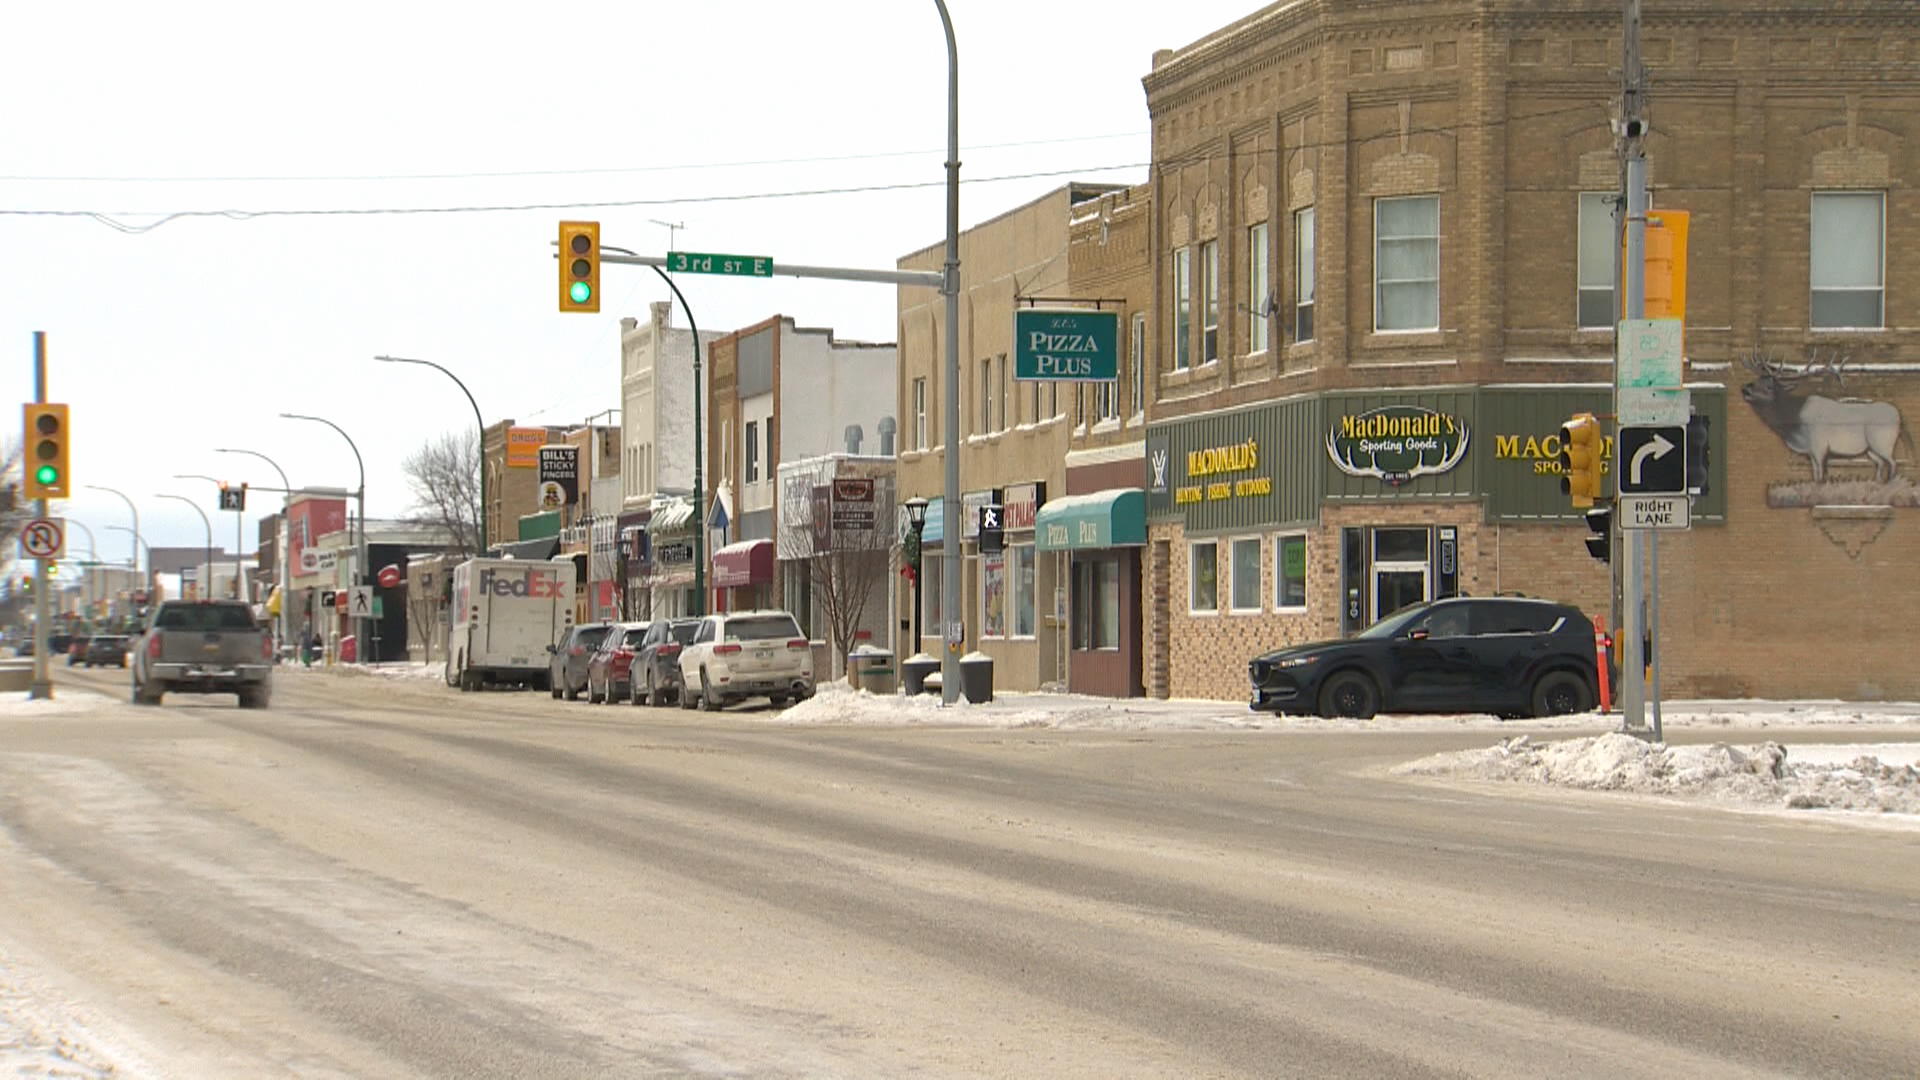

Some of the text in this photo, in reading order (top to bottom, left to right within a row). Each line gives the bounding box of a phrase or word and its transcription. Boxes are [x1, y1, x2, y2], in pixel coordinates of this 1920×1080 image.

[676, 255, 766, 274] 3rd ST E
[1029, 331, 1098, 352] PIZZA
[1035, 355, 1092, 375] PLUS
[1341, 412, 1455, 438] MacDonald's
[1360, 436, 1438, 454] Sporting Goods
[542, 450, 575, 460] BILL'S
[1187, 437, 1258, 476] MACDONALD'S
[542, 470, 576, 479] FINGERS
[543, 461, 575, 470] STICKY
[1176, 477, 1272, 503] HUNTING FISHING OUTDOORS
[1635, 500, 1673, 512] RIGHT
[1635, 513, 1672, 525] LANE
[1048, 520, 1097, 546] PIZZA PLUS
[480, 569, 567, 598] FedEx
